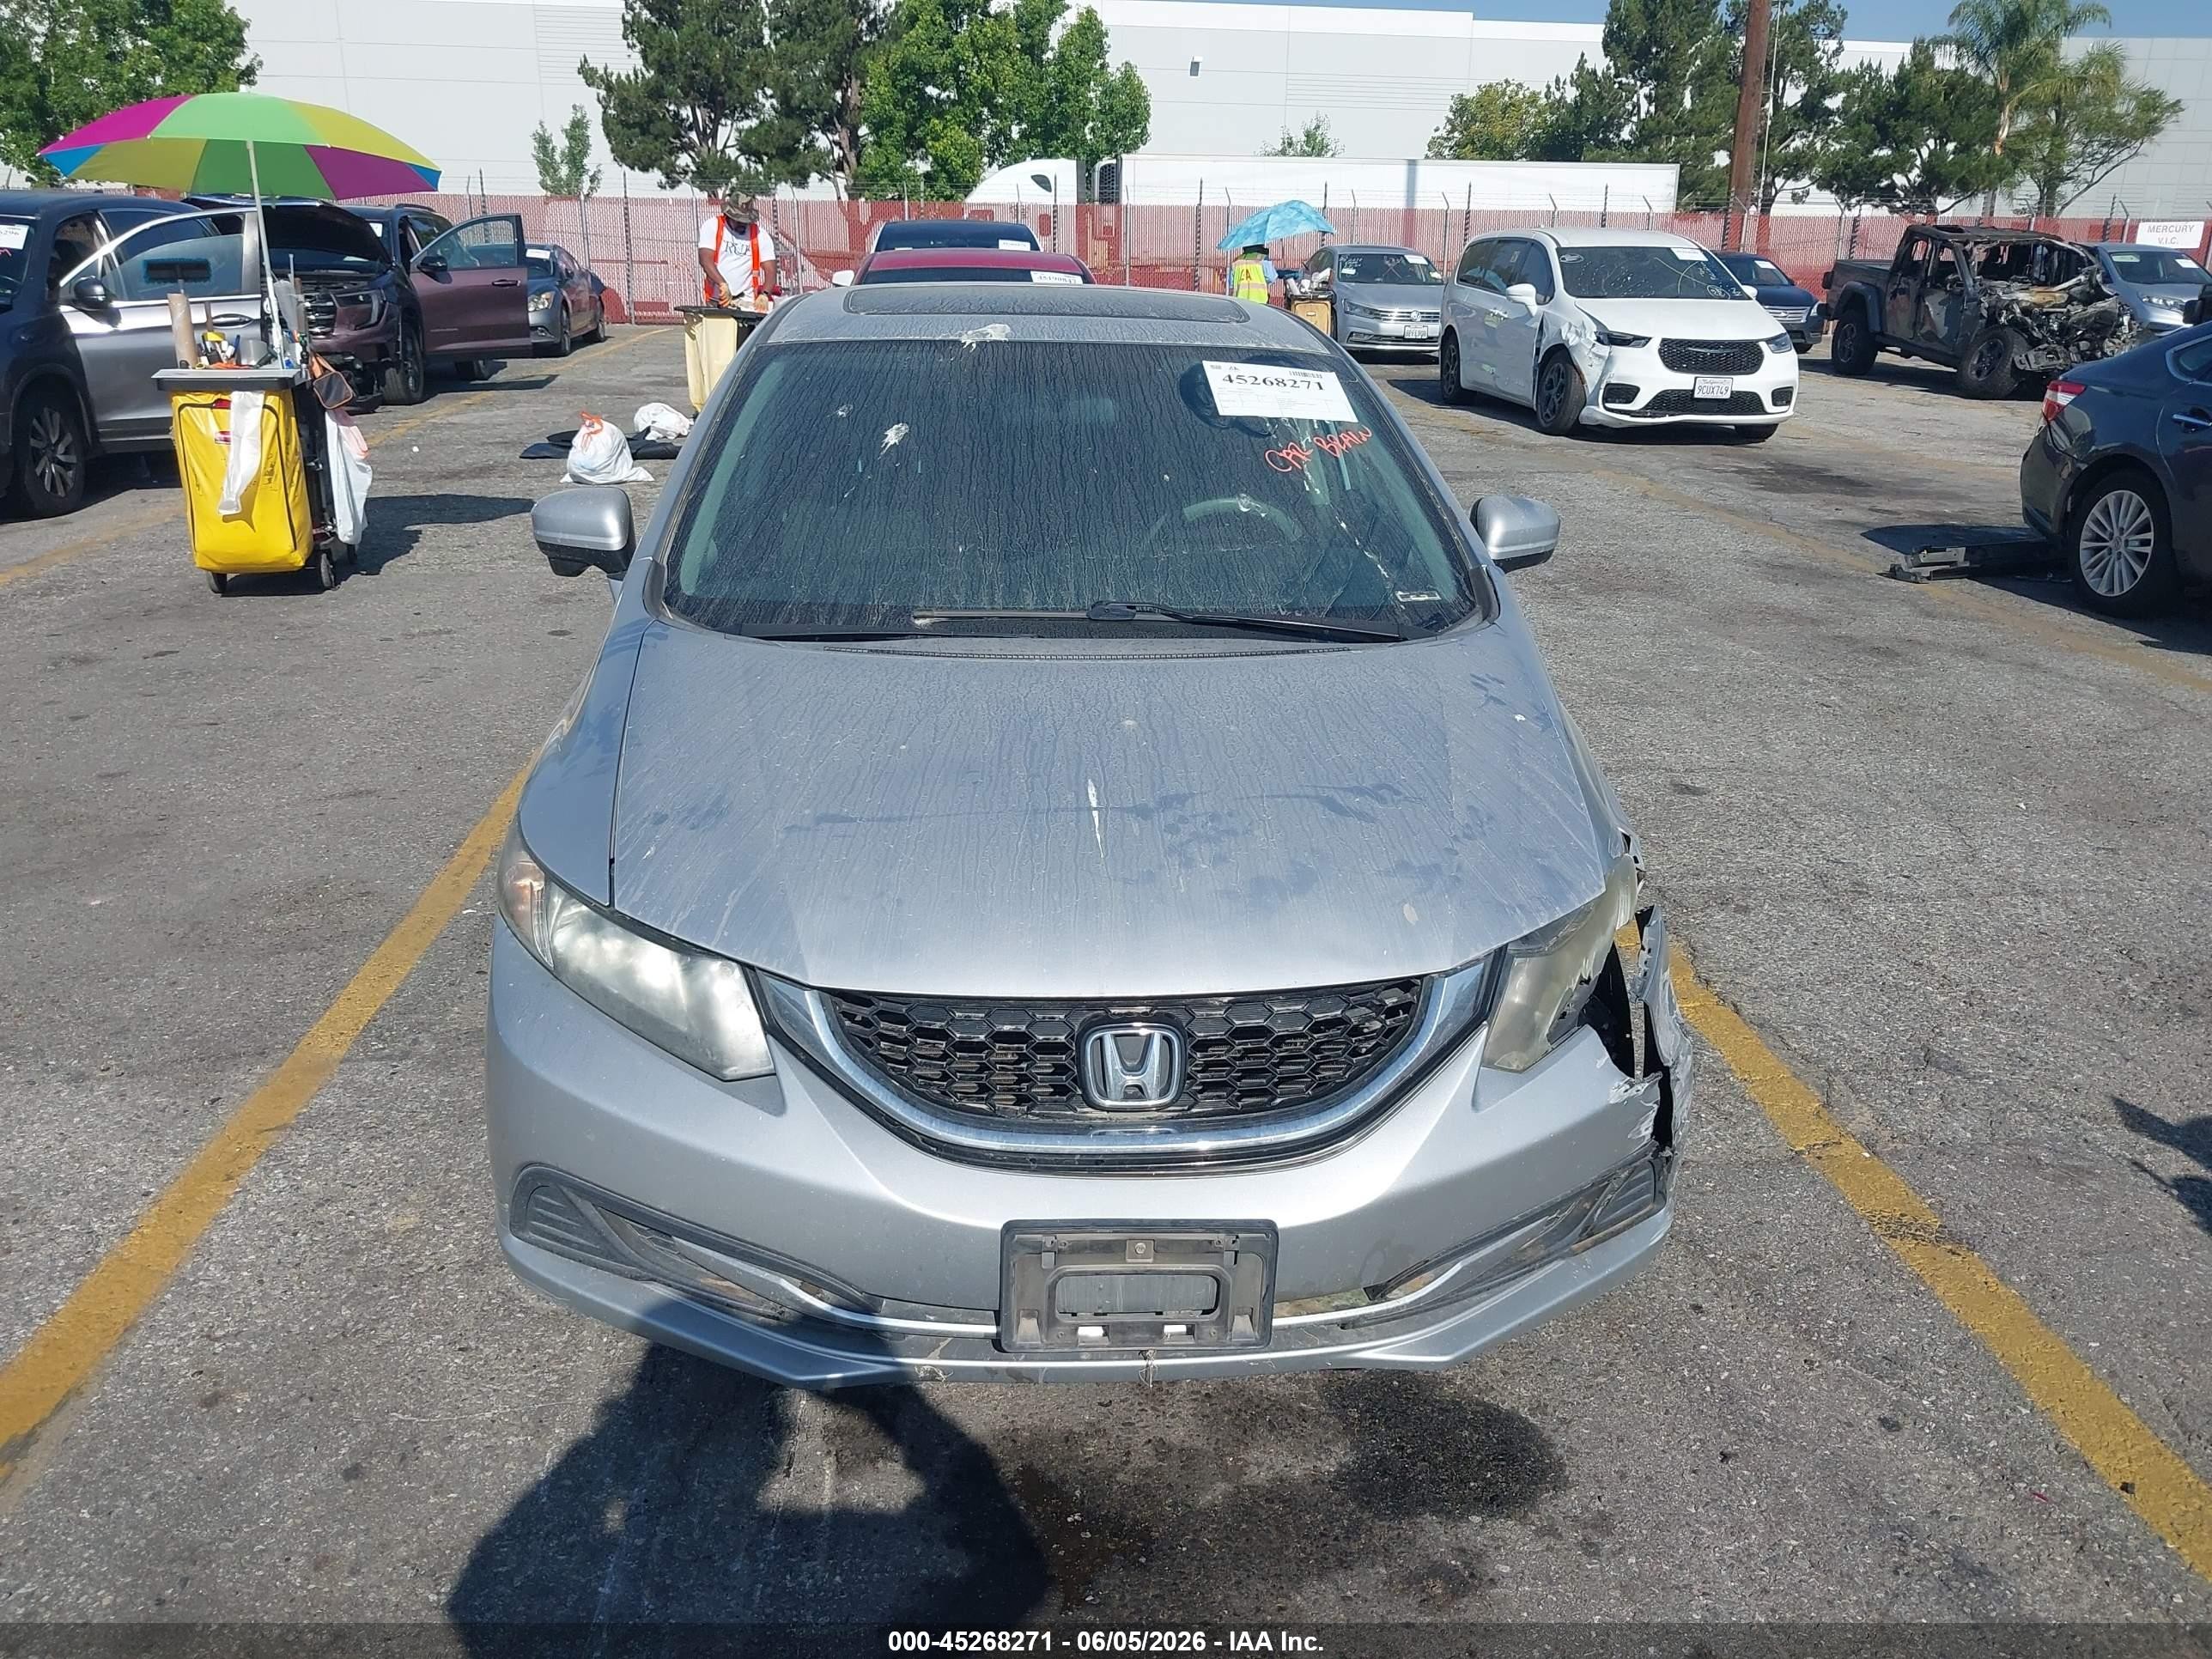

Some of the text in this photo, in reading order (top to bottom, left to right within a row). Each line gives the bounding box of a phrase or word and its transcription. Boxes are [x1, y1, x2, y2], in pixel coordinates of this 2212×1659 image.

[2148, 224, 2195, 233] MERCURY
[2157, 236, 2179, 245] V.I.C.
[1222, 374, 1324, 391] 45268271
[1697, 385, 1729, 396] 9CUX749
